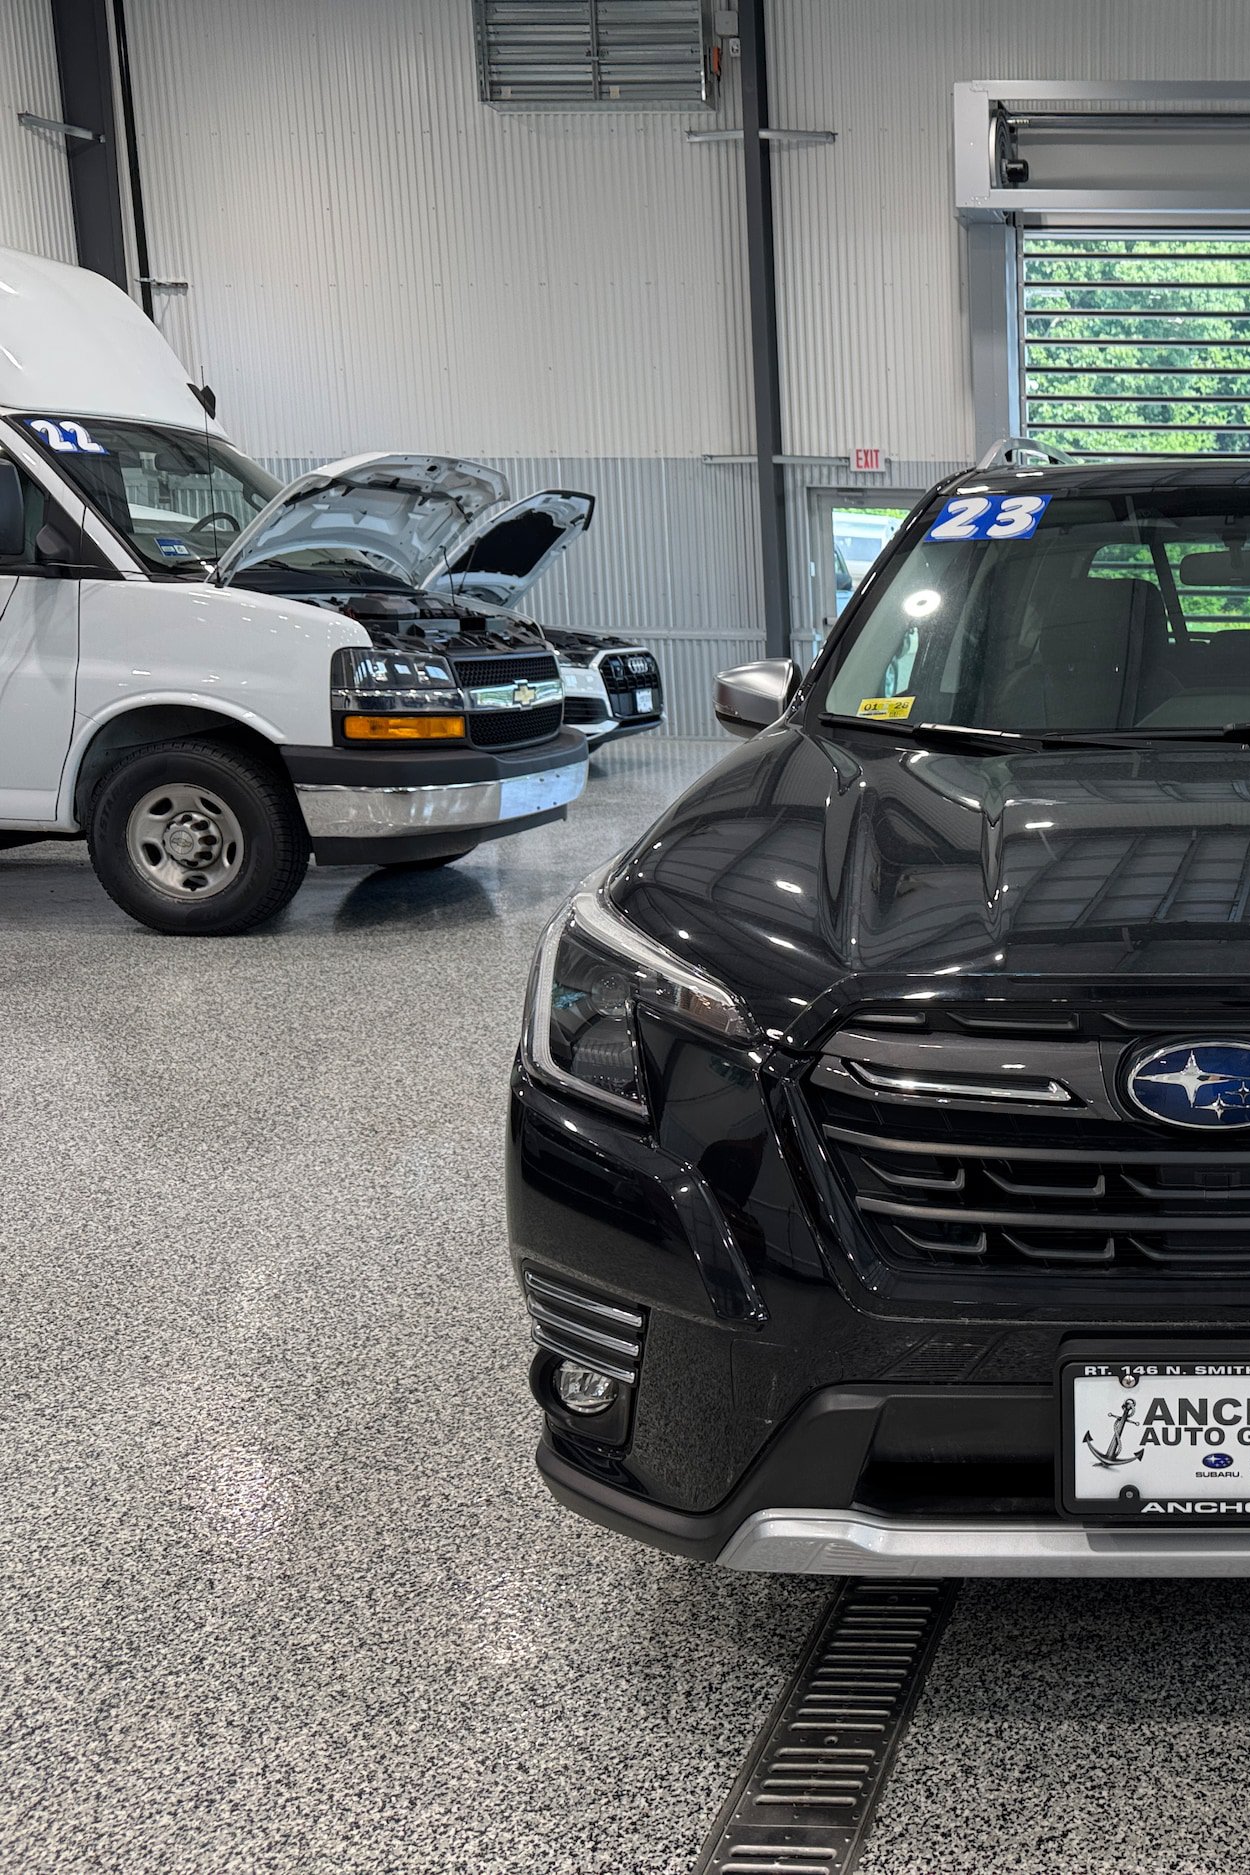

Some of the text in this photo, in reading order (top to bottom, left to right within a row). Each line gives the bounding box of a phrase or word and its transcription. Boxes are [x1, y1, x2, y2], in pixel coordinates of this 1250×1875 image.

[30, 419, 105, 453] 22
[855, 448, 880, 470] EXIT
[930, 496, 1046, 539] 23
[1084, 1365, 1113, 1376] RT.
[1121, 1365, 1159, 1376] 146
[1165, 1365, 1188, 1376] N.
[1139, 1427, 1226, 1446] AUTO
[1195, 1471, 1241, 1479] SUBARU
